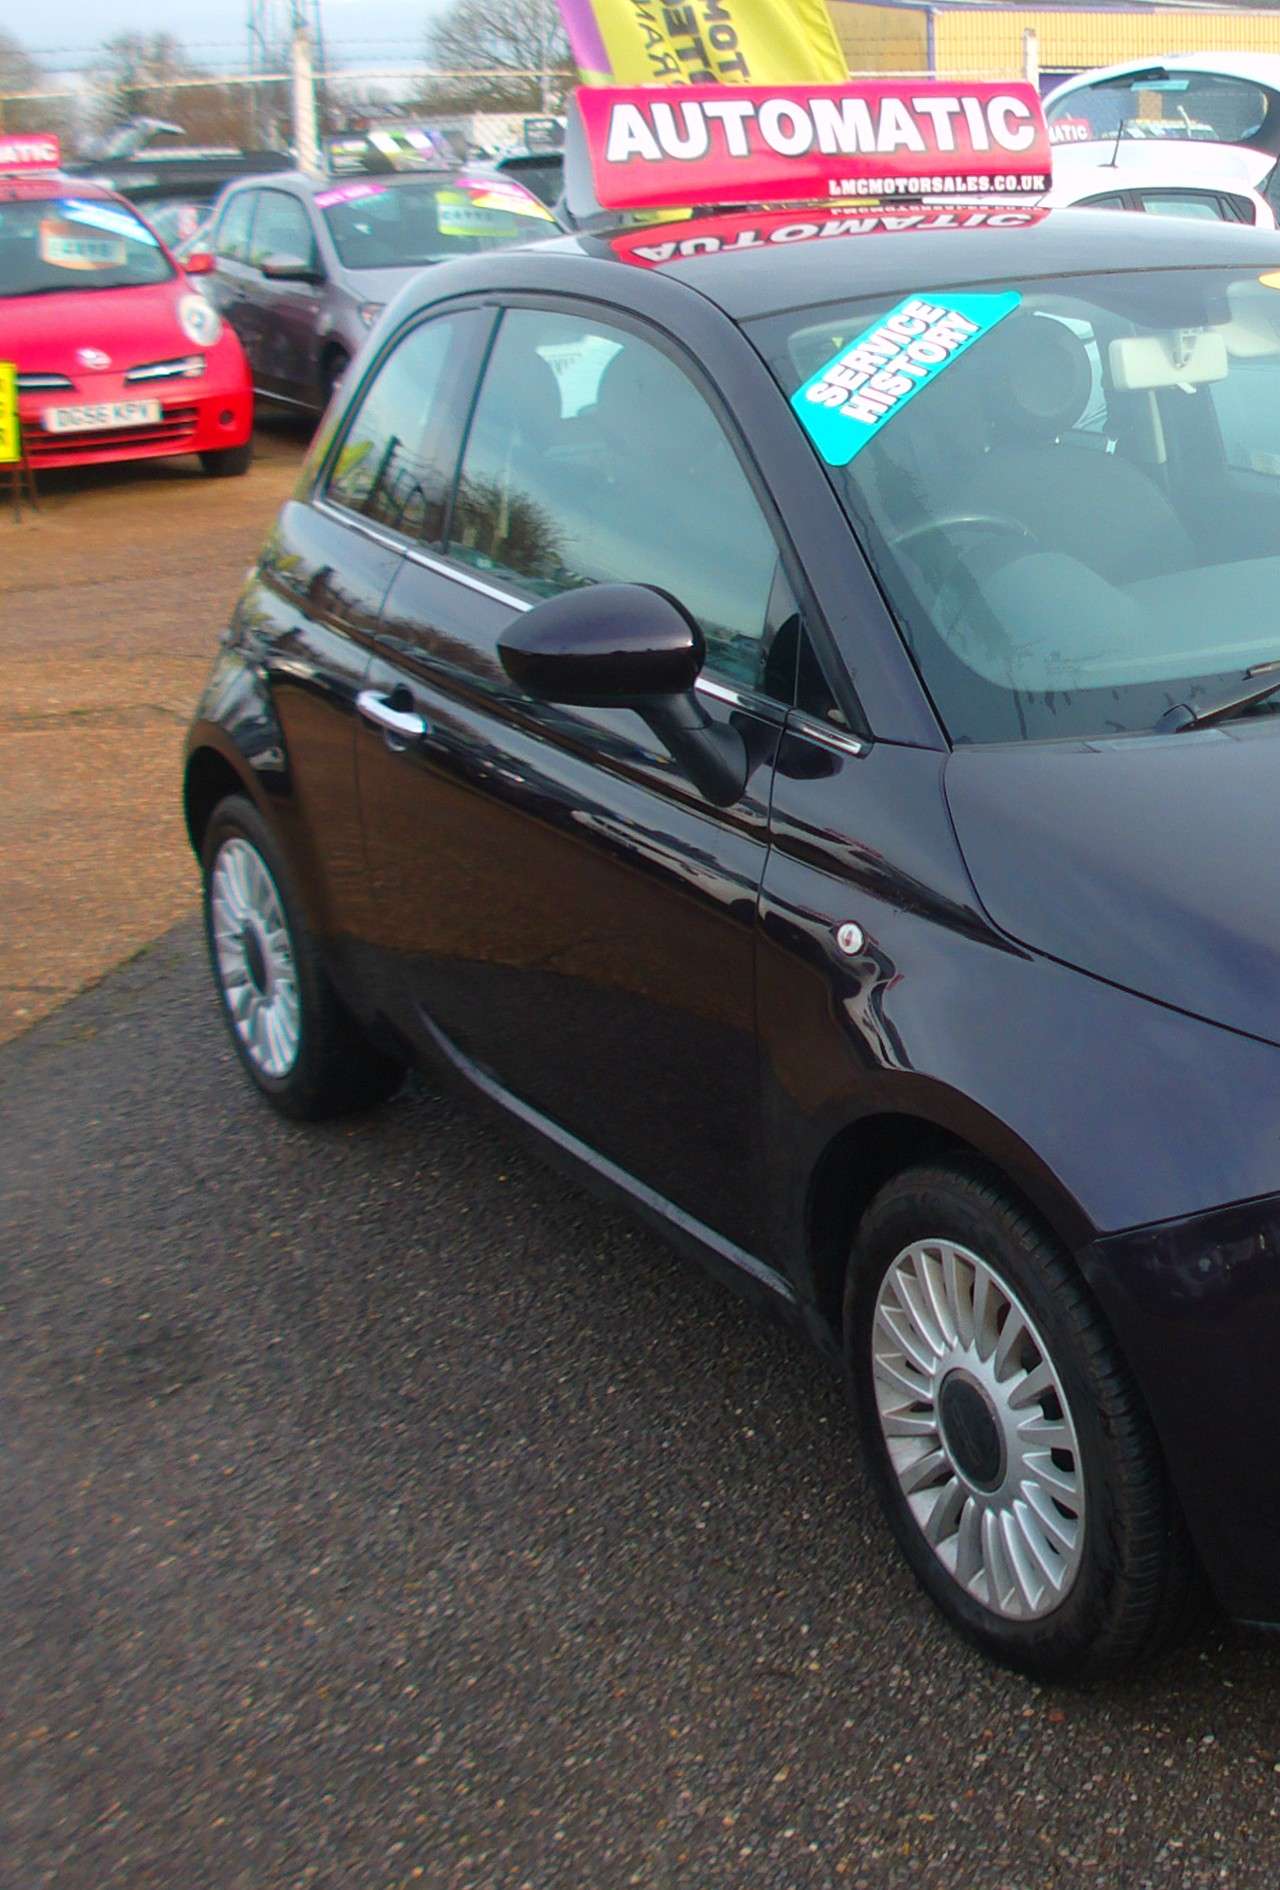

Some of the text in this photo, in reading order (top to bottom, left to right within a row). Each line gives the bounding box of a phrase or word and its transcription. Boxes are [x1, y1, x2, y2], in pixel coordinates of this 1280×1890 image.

[606, 96, 1036, 162] AUTOMATIC
[828, 175, 1046, 196] LMCMOTORSALES.CO.UK
[806, 300, 947, 408] SERVICE
[840, 311, 982, 425] HISTORY
